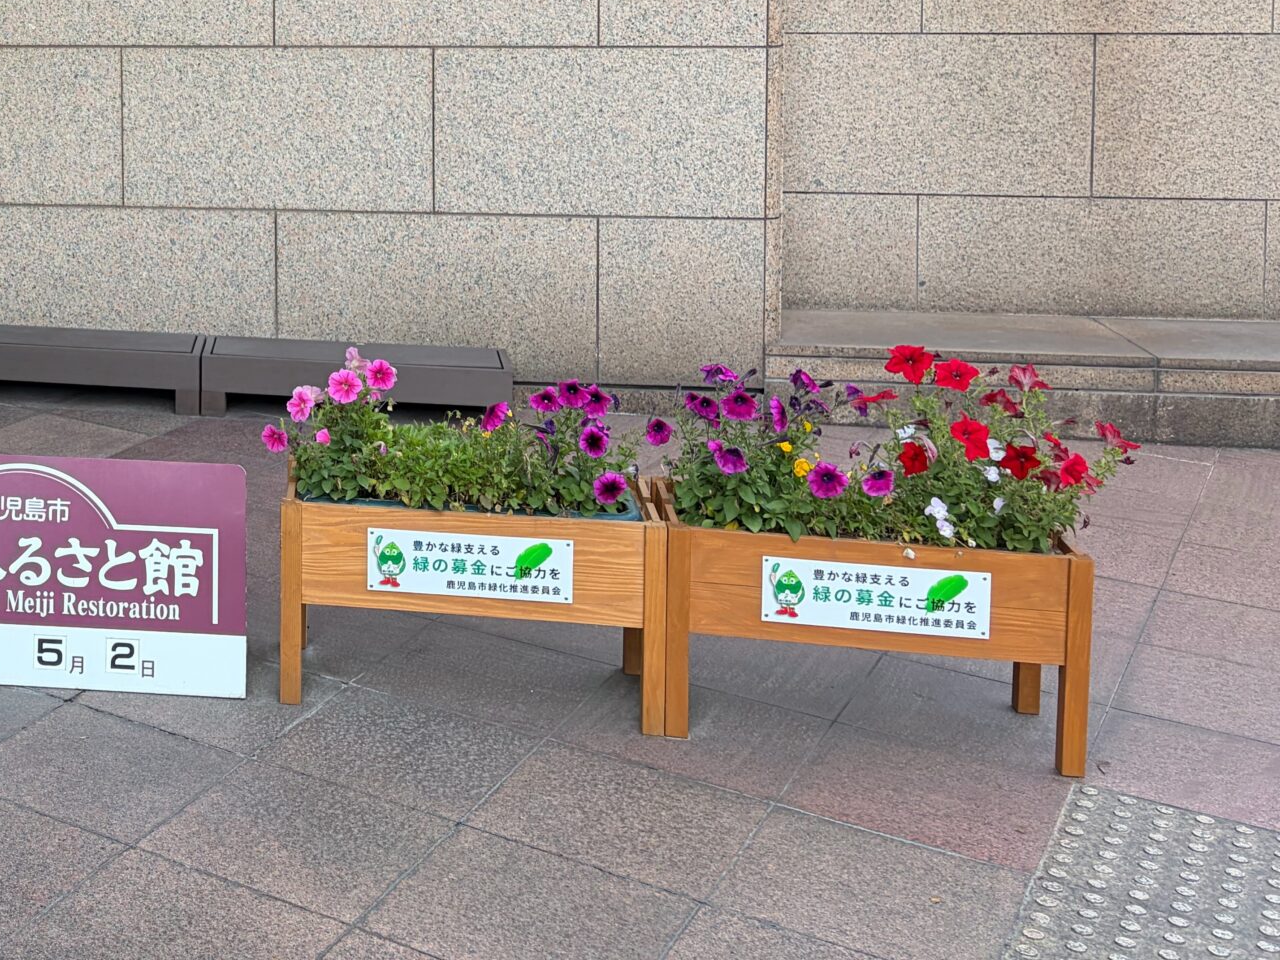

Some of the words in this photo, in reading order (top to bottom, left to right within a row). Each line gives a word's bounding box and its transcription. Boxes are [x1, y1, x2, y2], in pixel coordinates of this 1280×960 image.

[412, 540, 500, 556] 豊かな緑支える
[412, 556, 561, 580] 緑の募金にご協力を
[813, 569, 910, 587] 豊かな緑支える
[446, 580, 561, 596] 鹿児島市緑化推進委員会
[6, 592, 56, 616] Meiji
[62, 592, 180, 620] Restoration
[812, 585, 977, 614] 緑の募金にご協力を
[849, 611, 978, 630] 鹿児島市緑化推進委員会
[36, 639, 85, 675] 5月
[110, 643, 156, 678] 2日
